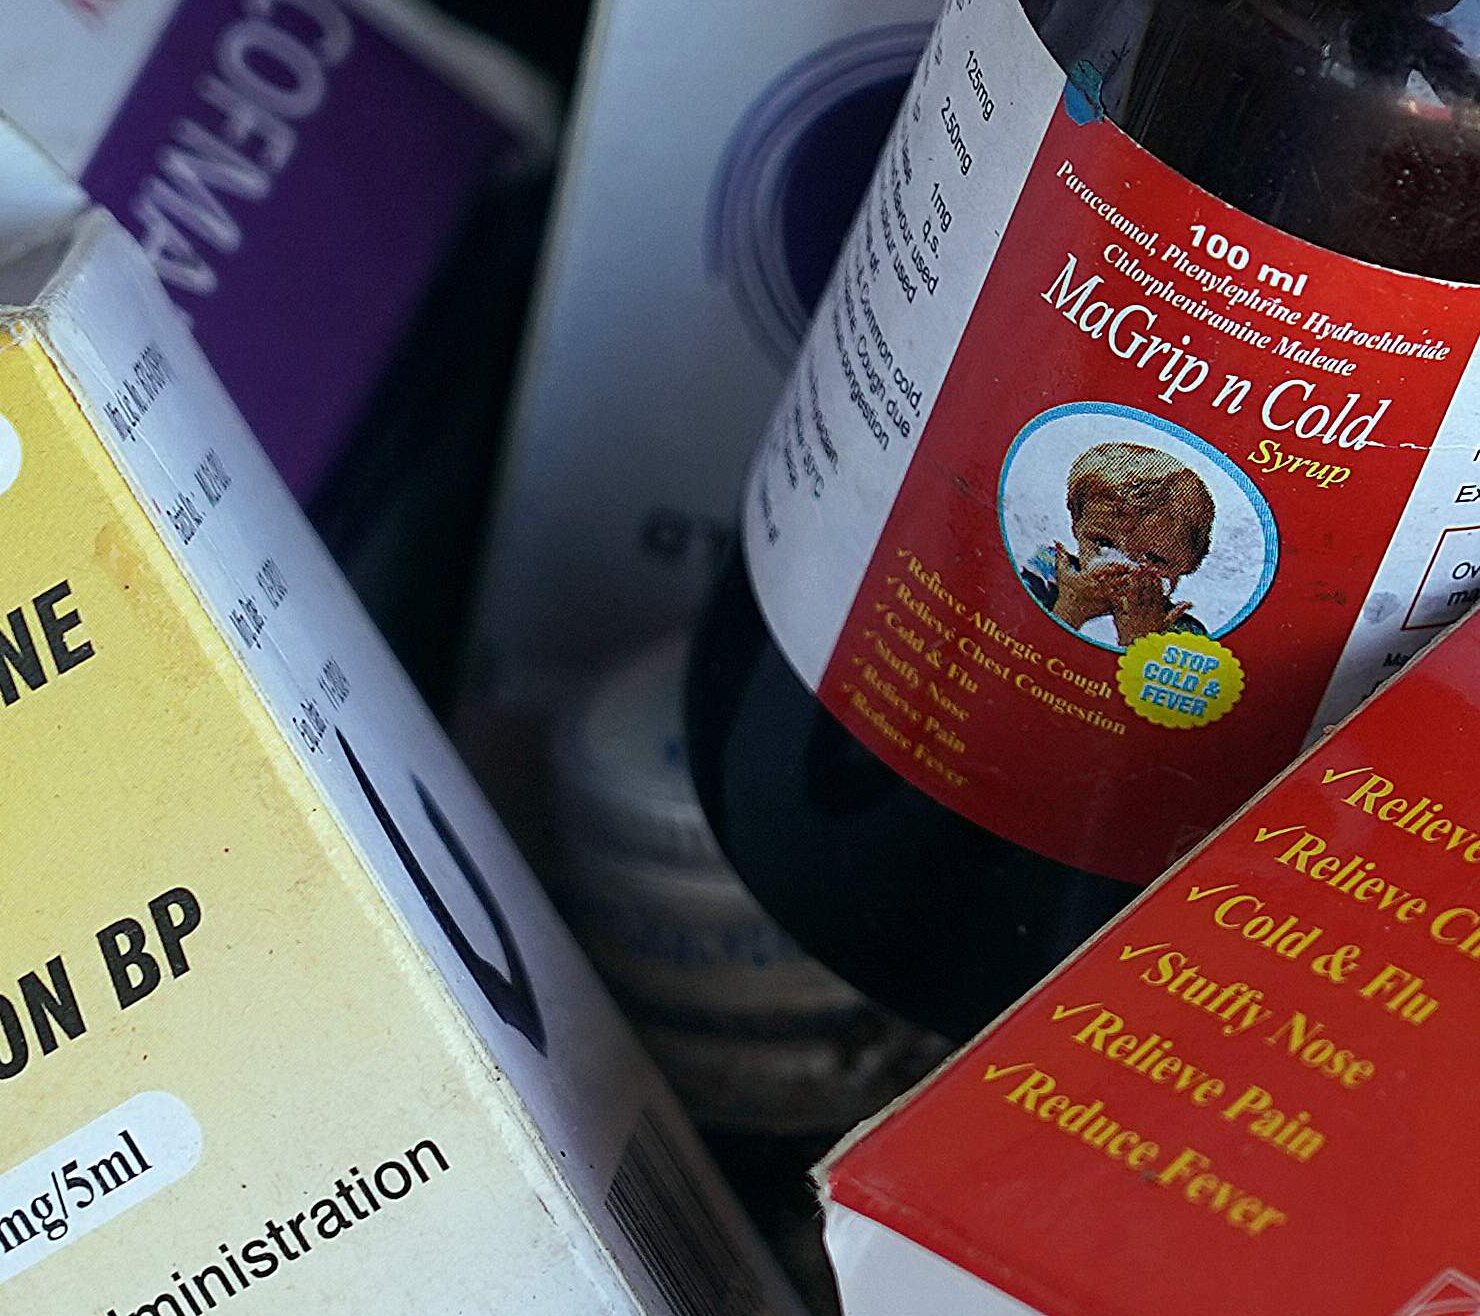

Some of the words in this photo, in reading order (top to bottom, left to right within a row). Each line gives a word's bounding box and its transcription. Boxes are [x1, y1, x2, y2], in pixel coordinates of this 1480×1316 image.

[1190, 224, 1257, 270] 100
[1257, 264, 1308, 296] ml
[1040, 252, 1210, 404] MaGrip
[1211, 374, 1252, 415] n
[1261, 378, 1392, 451] Cold
[1269, 334, 1361, 382] Maleate
[1298, 312, 1453, 367] Hydrochloride
[1247, 440, 1351, 489] Syrup
[1136, 656, 1208, 698] COLD
[1140, 677, 1213, 716] FEVER
[1157, 640, 1225, 681] STOP
[1275, 825, 1427, 922] Relieve
[94, 883, 204, 1011] BP
[1214, 884, 1320, 959] Cold
[1311, 945, 1361, 982] &
[1359, 965, 1438, 1024] Flu
[1140, 944, 1272, 1035] Stuffy
[1289, 1011, 1374, 1085] Nose
[1074, 1003, 1225, 1103] Relieve
[1218, 1085, 1324, 1171] Pain
[1006, 1063, 1159, 1182] Reduce
[1159, 1148, 1286, 1233] Fever
